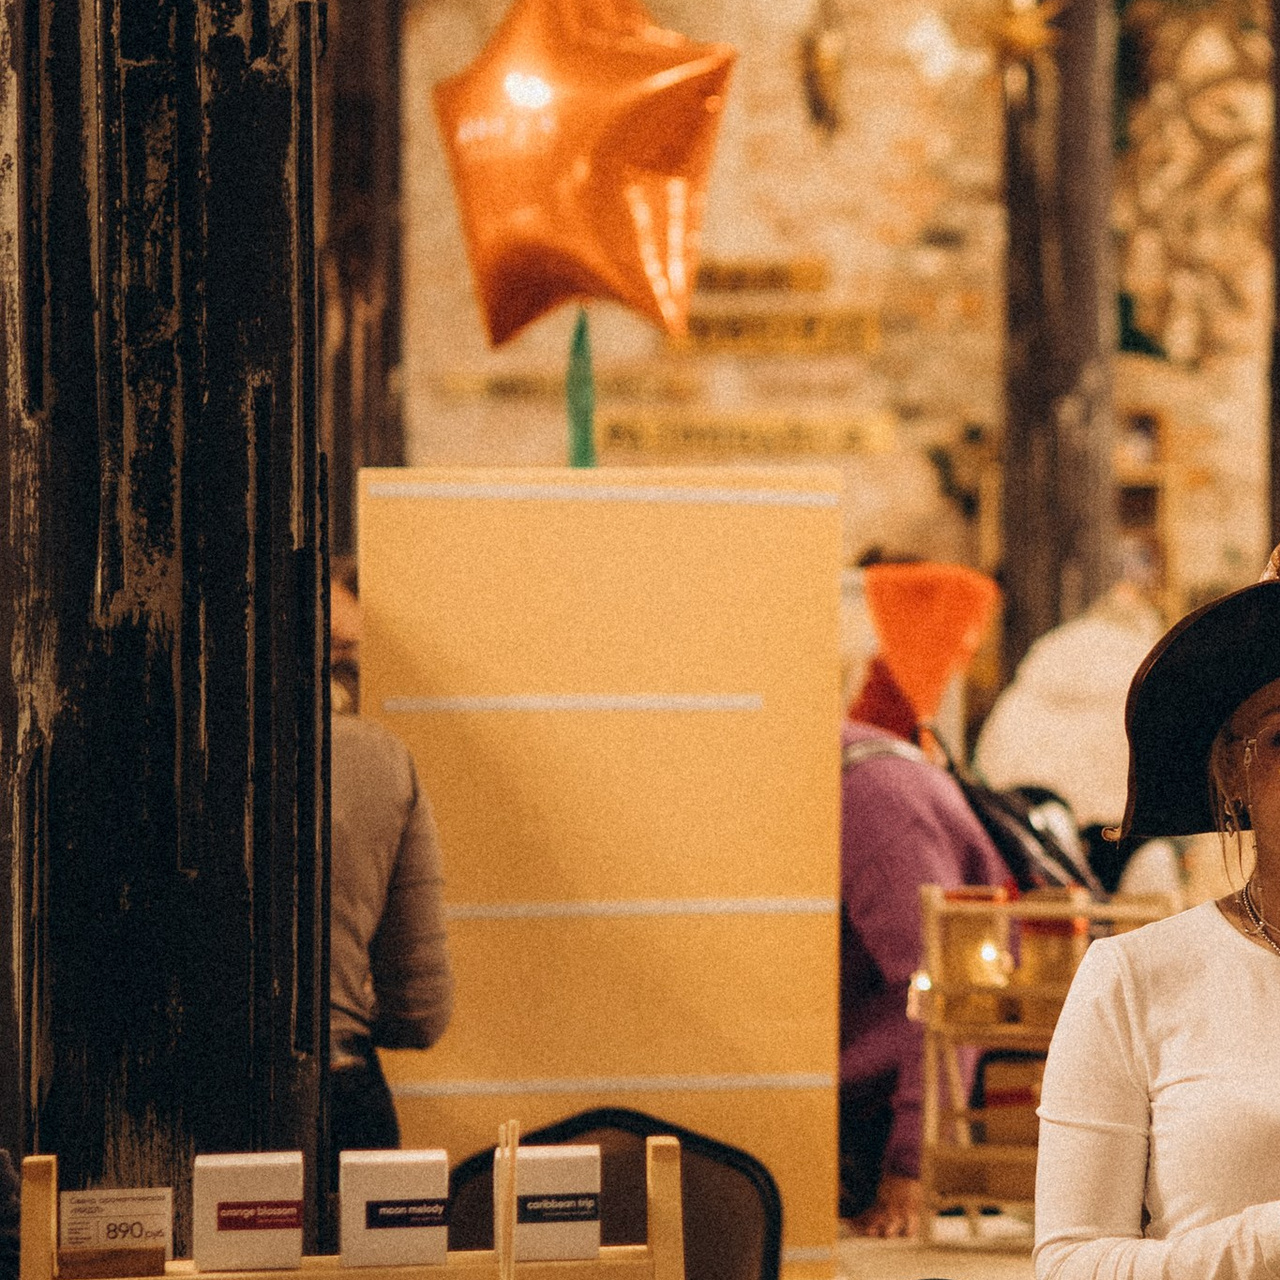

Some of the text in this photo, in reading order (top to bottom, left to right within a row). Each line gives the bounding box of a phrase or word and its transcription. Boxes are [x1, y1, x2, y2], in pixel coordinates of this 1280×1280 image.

[379, 1204, 445, 1216] moon melody
[527, 1198, 596, 1210] caribbean trip
[220, 1205, 297, 1219] orange blossom
[106, 1221, 144, 1240] 890
